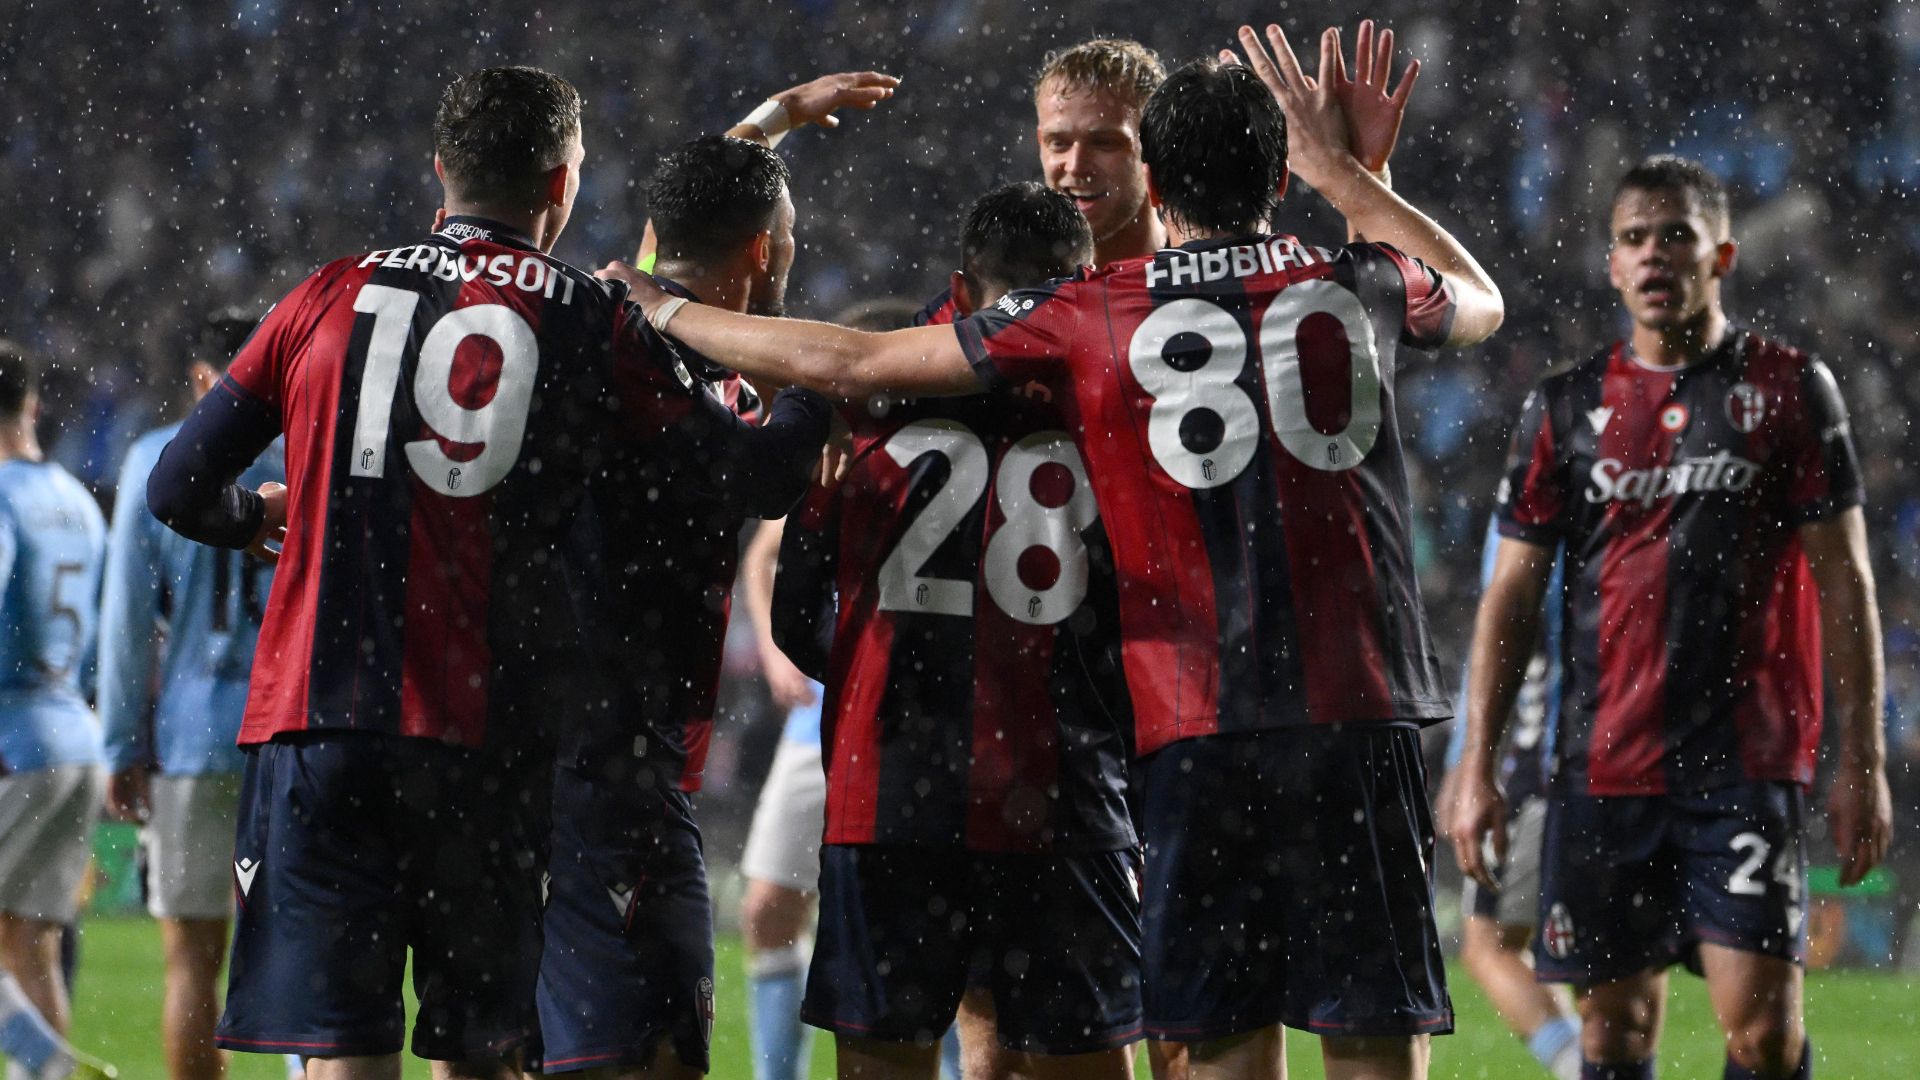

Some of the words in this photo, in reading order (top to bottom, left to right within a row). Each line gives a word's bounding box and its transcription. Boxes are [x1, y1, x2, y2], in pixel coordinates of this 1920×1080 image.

[358, 244, 576, 306] FERGUSON
[350, 283, 540, 498] 19
[1128, 278, 1382, 490] 80
[877, 418, 1099, 626] 28
[1585, 450, 1762, 509] Saputo
[34, 562, 84, 682] 5
[1728, 832, 1801, 903] 24
